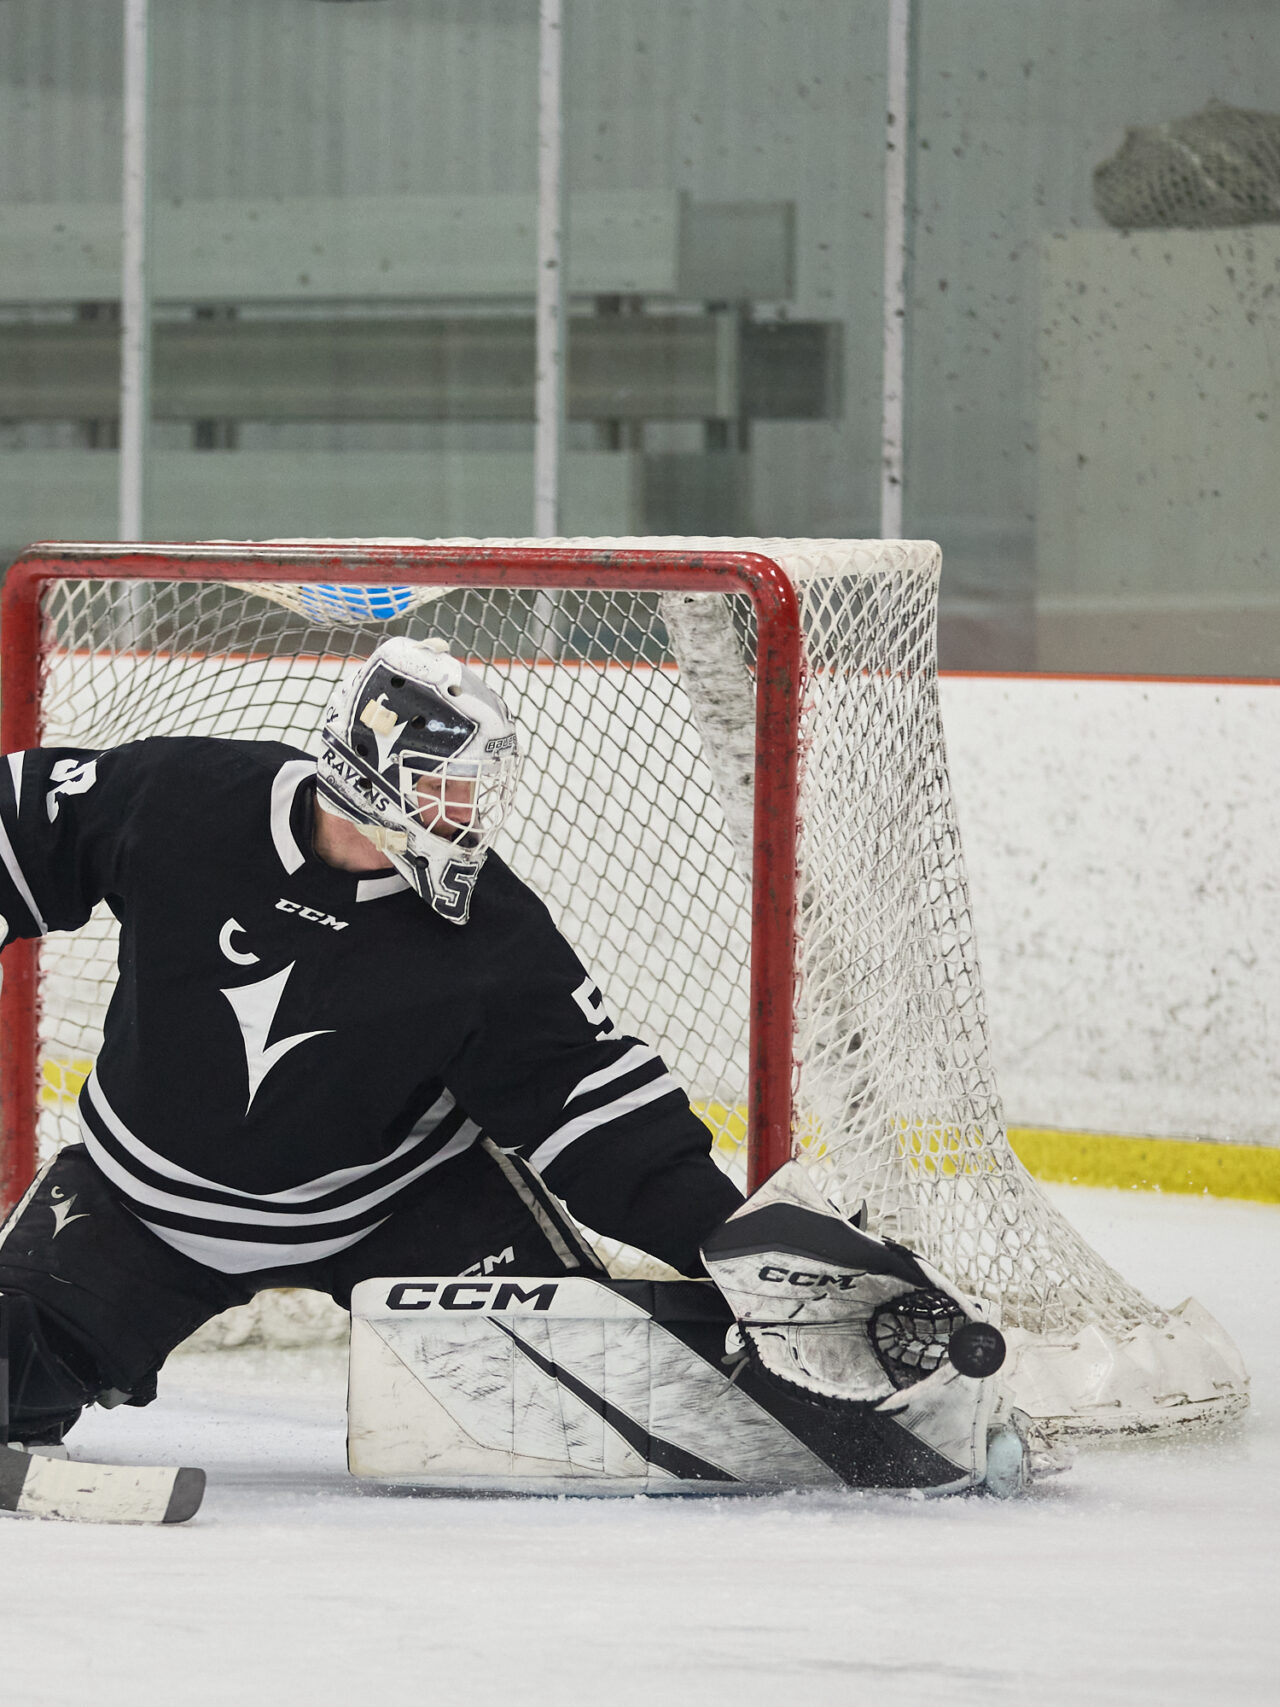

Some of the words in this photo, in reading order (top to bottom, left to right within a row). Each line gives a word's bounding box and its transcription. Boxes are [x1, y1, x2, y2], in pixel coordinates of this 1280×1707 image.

[321, 747, 390, 812] RAVENS
[431, 859, 480, 920] 5
[275, 898, 350, 931] CCM
[758, 1266, 858, 1291] CCM
[385, 1283, 559, 1311] CCM
